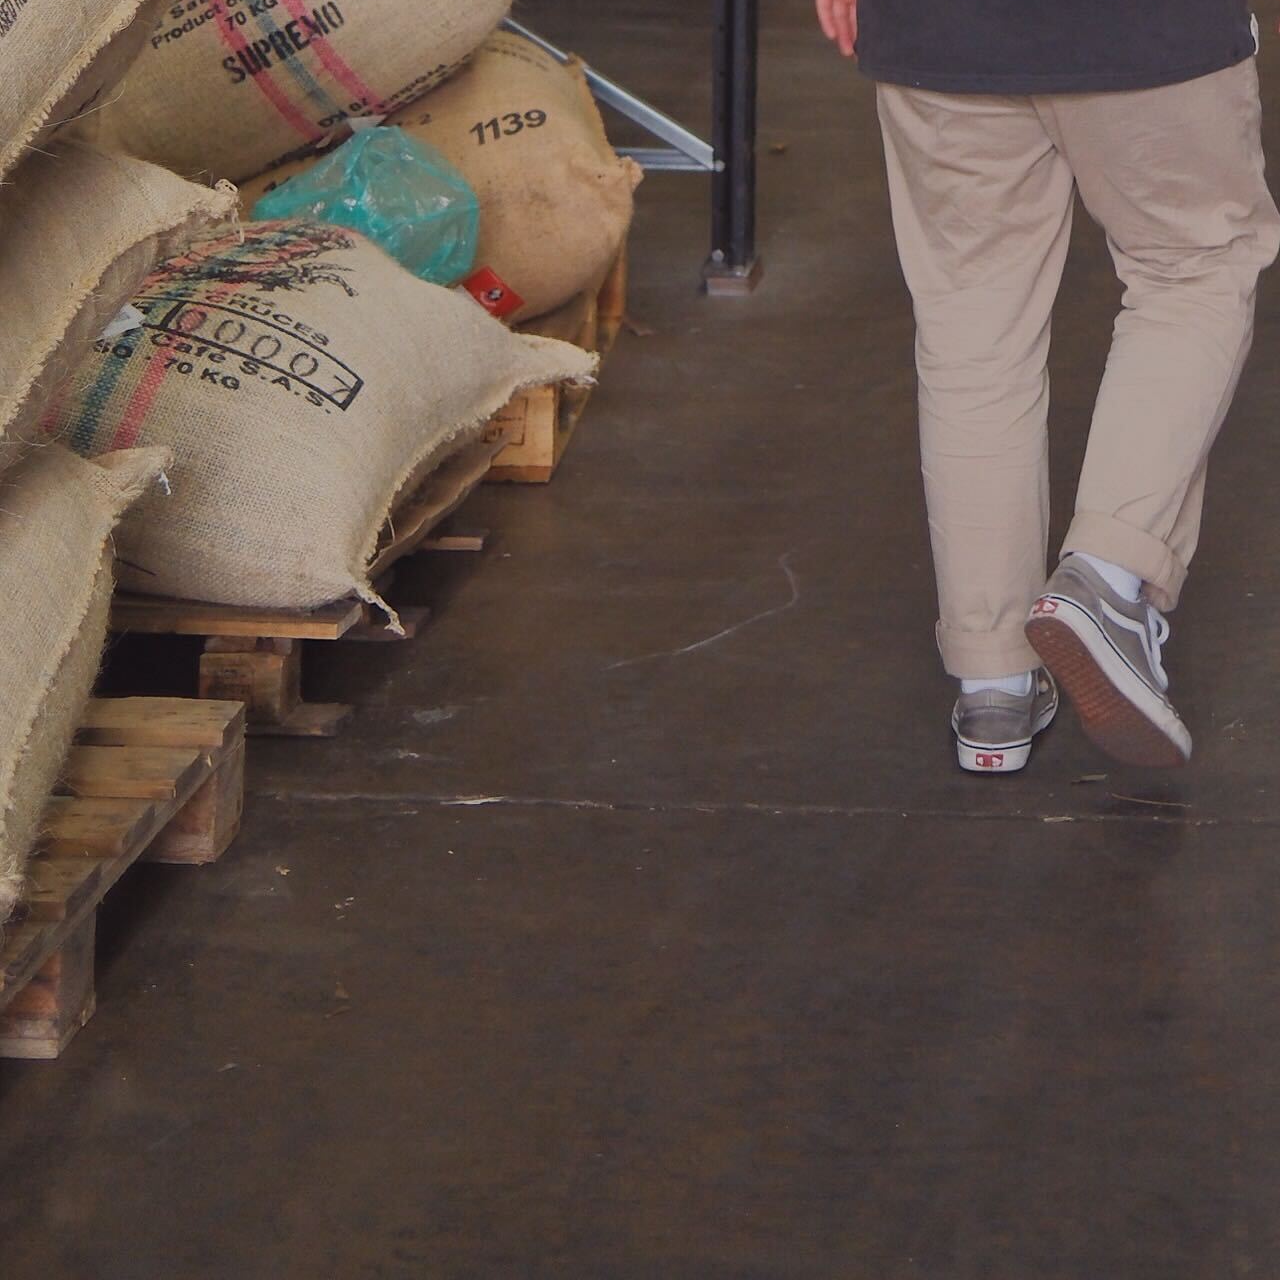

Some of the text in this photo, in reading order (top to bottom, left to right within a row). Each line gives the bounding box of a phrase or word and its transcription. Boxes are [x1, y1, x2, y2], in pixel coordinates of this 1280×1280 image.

[151, 1, 222, 50] Product
[224, 10, 247, 31] 70
[222, 0, 345, 84] SUPREMO
[469, 107, 548, 146] 1139
[205, 294, 330, 347] CRUCES
[151, 332, 227, 365] Café
[163, 356, 194, 375] 70
[201, 367, 241, 391] KG
